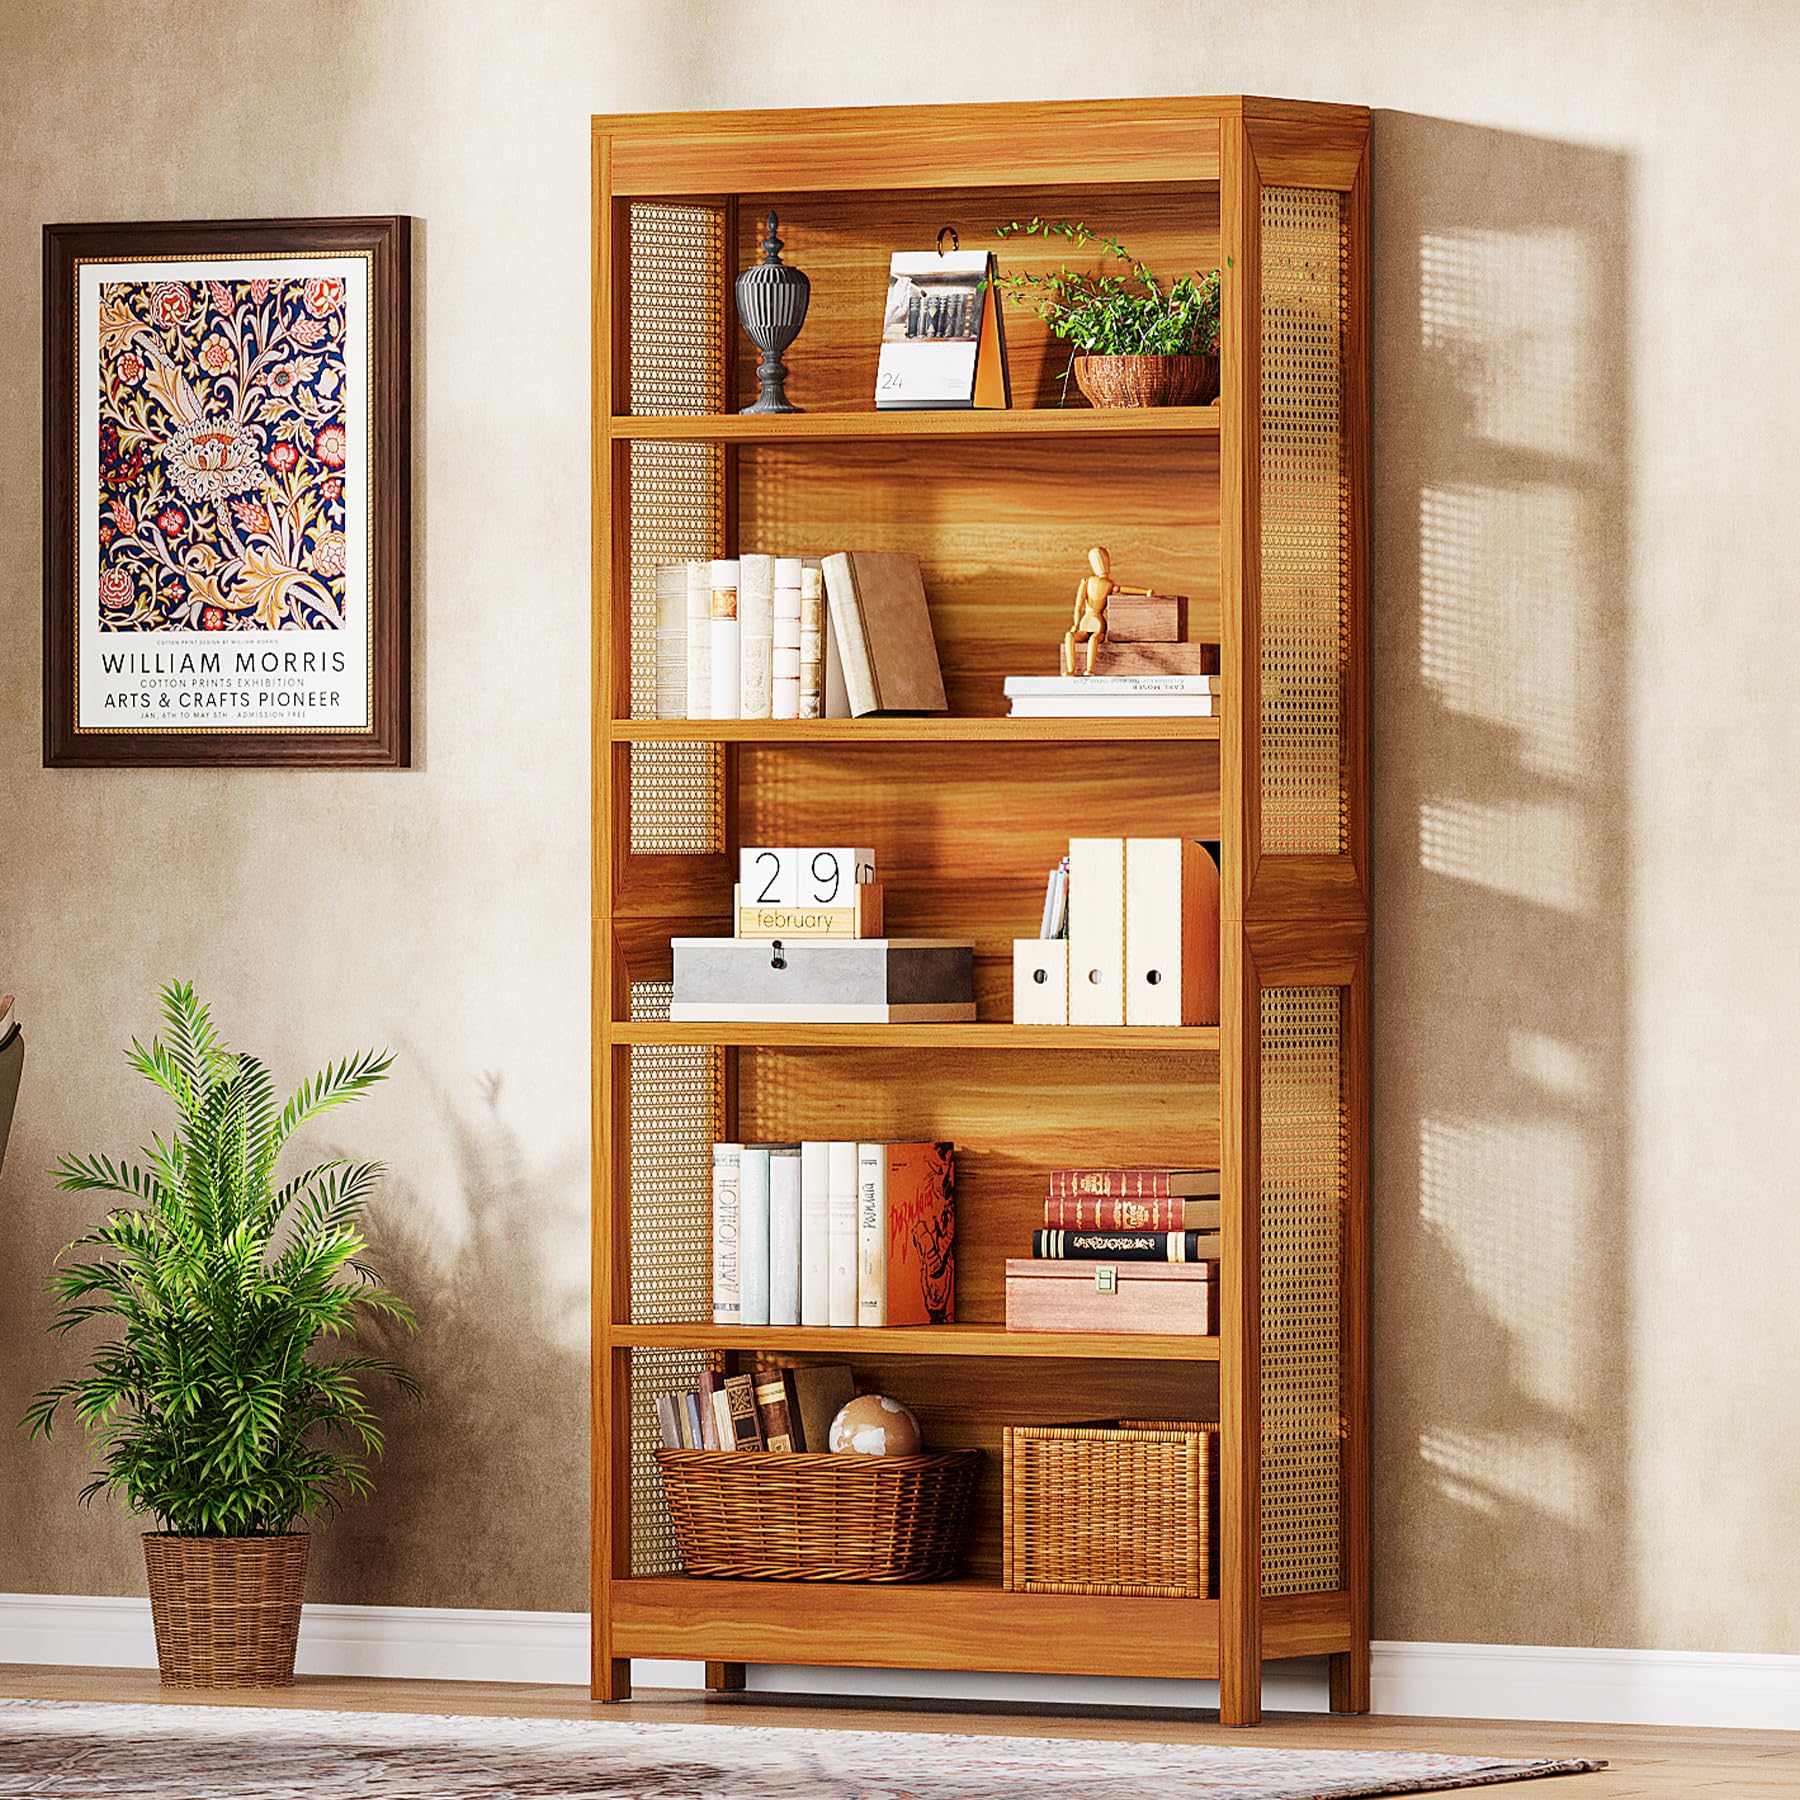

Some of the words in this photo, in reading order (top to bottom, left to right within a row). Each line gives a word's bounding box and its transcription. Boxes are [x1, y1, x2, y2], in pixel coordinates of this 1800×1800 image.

[882, 372, 903, 389] 24
[101, 653, 221, 674] WILLIAM
[235, 651, 345, 673] MORRIS
[140, 678, 187, 689] COTTON
[191, 678, 232, 688] PRINTS
[237, 677, 305, 687] EXHIBITION
[104, 692, 151, 708] ARTS
[158, 692, 171, 708] &
[178, 691, 250, 708] CRAFTS
[259, 691, 340, 707] PIONEER
[161, 711, 177, 719] 6TH
[180, 711, 191, 719] TO
[193, 711, 211, 719] MAY
[287, 710, 307, 718] FREE
[757, 908, 834, 933] february
